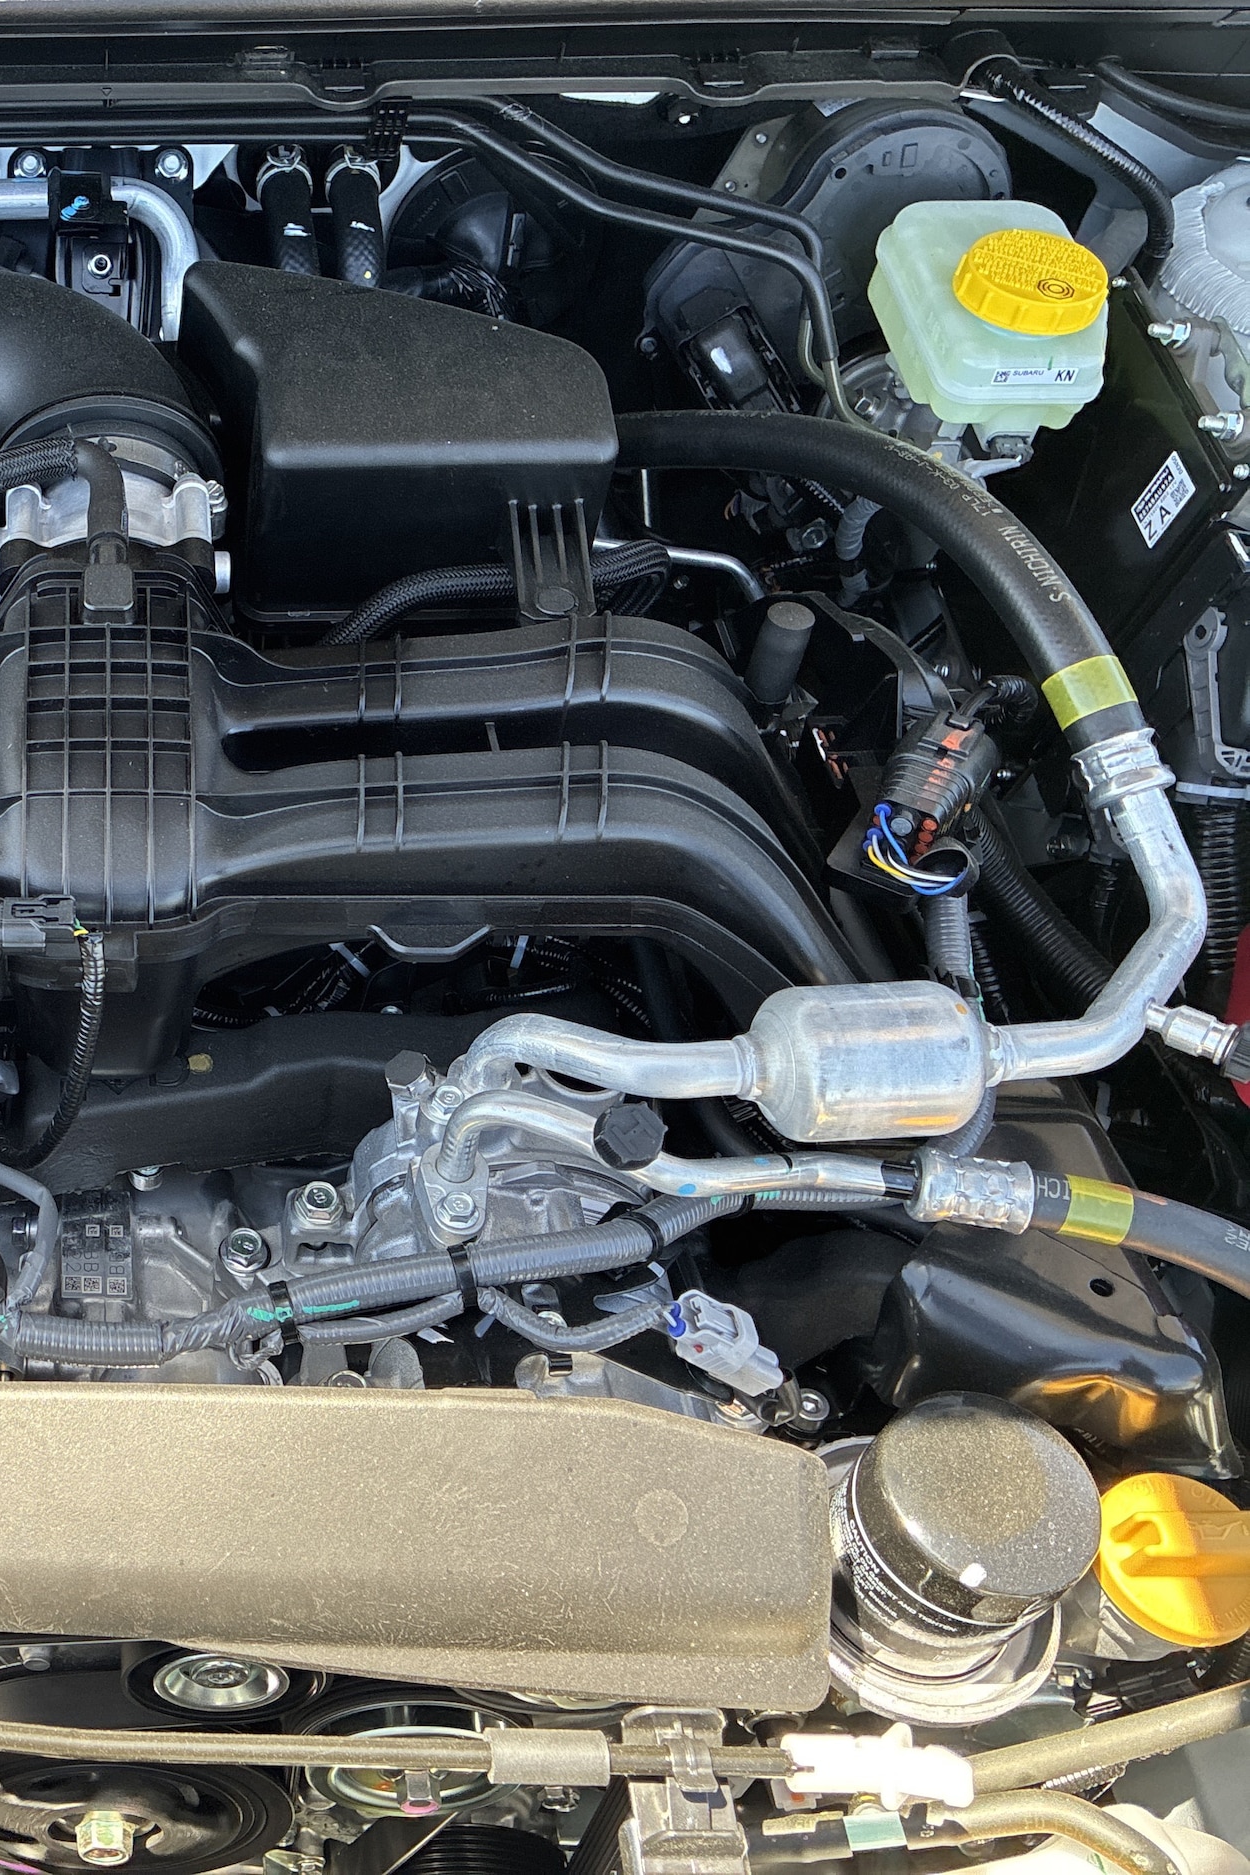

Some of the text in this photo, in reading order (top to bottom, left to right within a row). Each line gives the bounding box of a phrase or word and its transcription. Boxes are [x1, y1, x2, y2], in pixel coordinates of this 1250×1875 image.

[1054, 369, 1076, 382] KN
[1191, 1484, 1222, 1510] OIL
[849, 1519, 881, 1574] CAUTION
[869, 1570, 899, 1600] GASKET
[897, 1600, 918, 1615] AND
